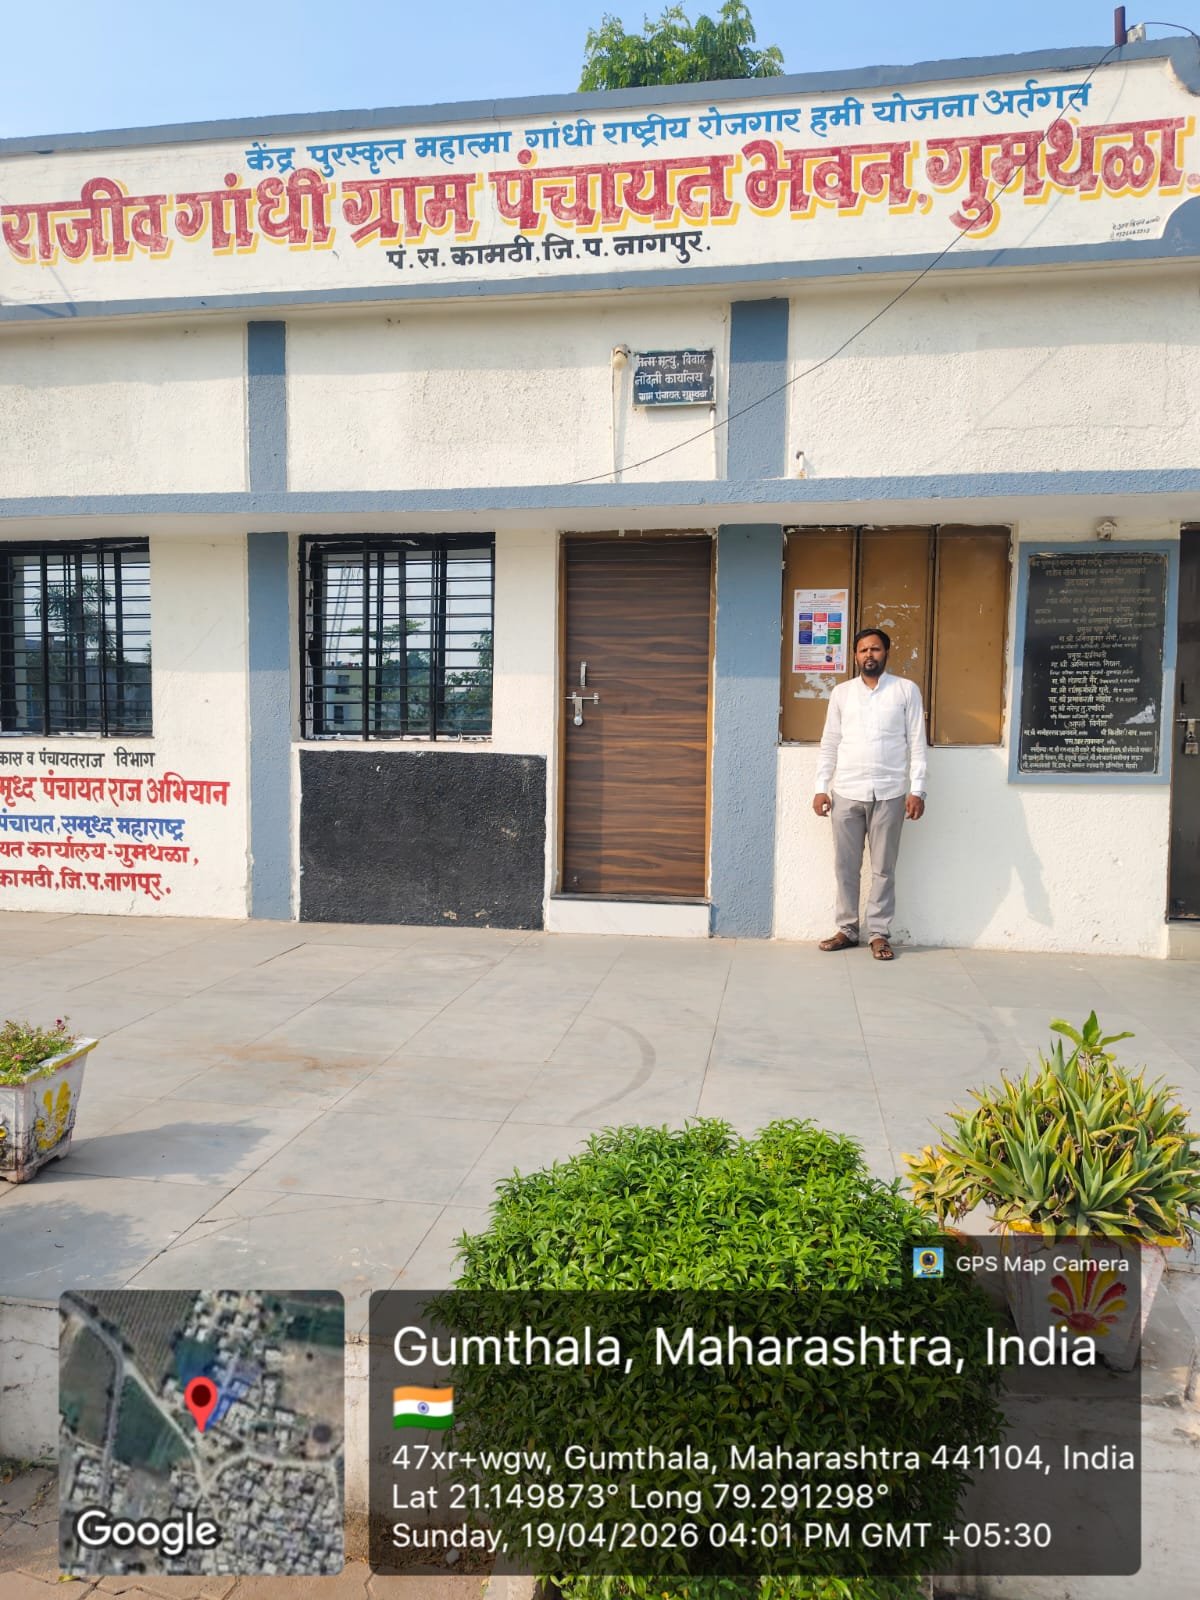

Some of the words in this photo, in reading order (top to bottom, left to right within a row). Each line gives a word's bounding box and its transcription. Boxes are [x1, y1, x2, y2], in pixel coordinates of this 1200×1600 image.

[246, 141, 296, 175] केंद्र
[307, 138, 405, 176] पुरस्कृत
[415, 130, 512, 165] महात्मा
[525, 119, 596, 149] गांधी
[603, 113, 691, 148] राष्ट्रीय
[698, 106, 802, 140] रोजगार
[810, 95, 862, 138] हमी
[872, 91, 979, 126] योजना
[0, 177, 168, 260] राजीव
[176, 168, 332, 249] गांधी
[341, 172, 478, 247] ग्राम
[488, 148, 738, 231] पंचायत
[27, 751, 35, 766] व
[39, 747, 105, 769] पंचायतराज
[113, 746, 156, 768] विभाग
[146, 771, 231, 807] अभियान
[116, 817, 186, 842] महाराष्ट्र
